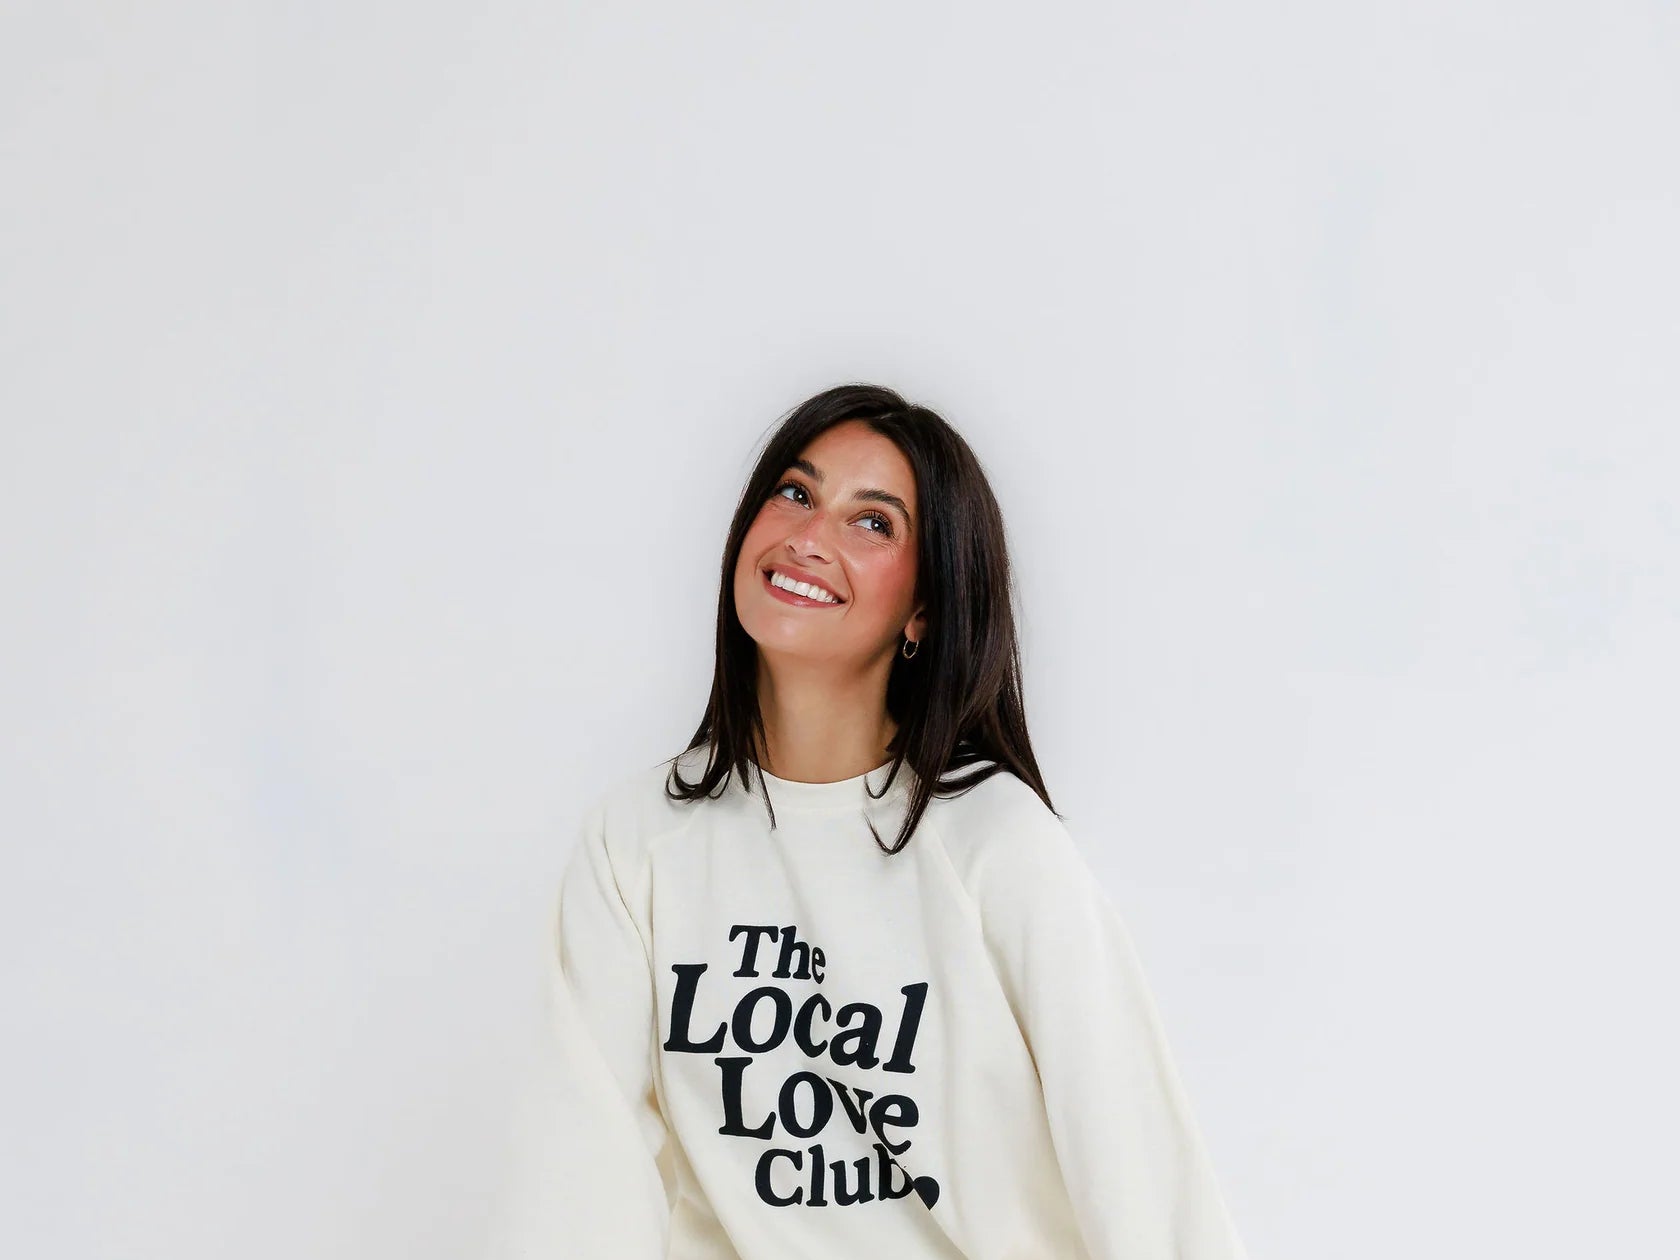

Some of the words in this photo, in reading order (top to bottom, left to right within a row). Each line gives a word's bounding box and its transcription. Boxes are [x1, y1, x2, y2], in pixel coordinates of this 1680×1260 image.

[728, 924, 826, 985] The
[663, 963, 929, 1074] Local
[714, 1056, 920, 1156] Love
